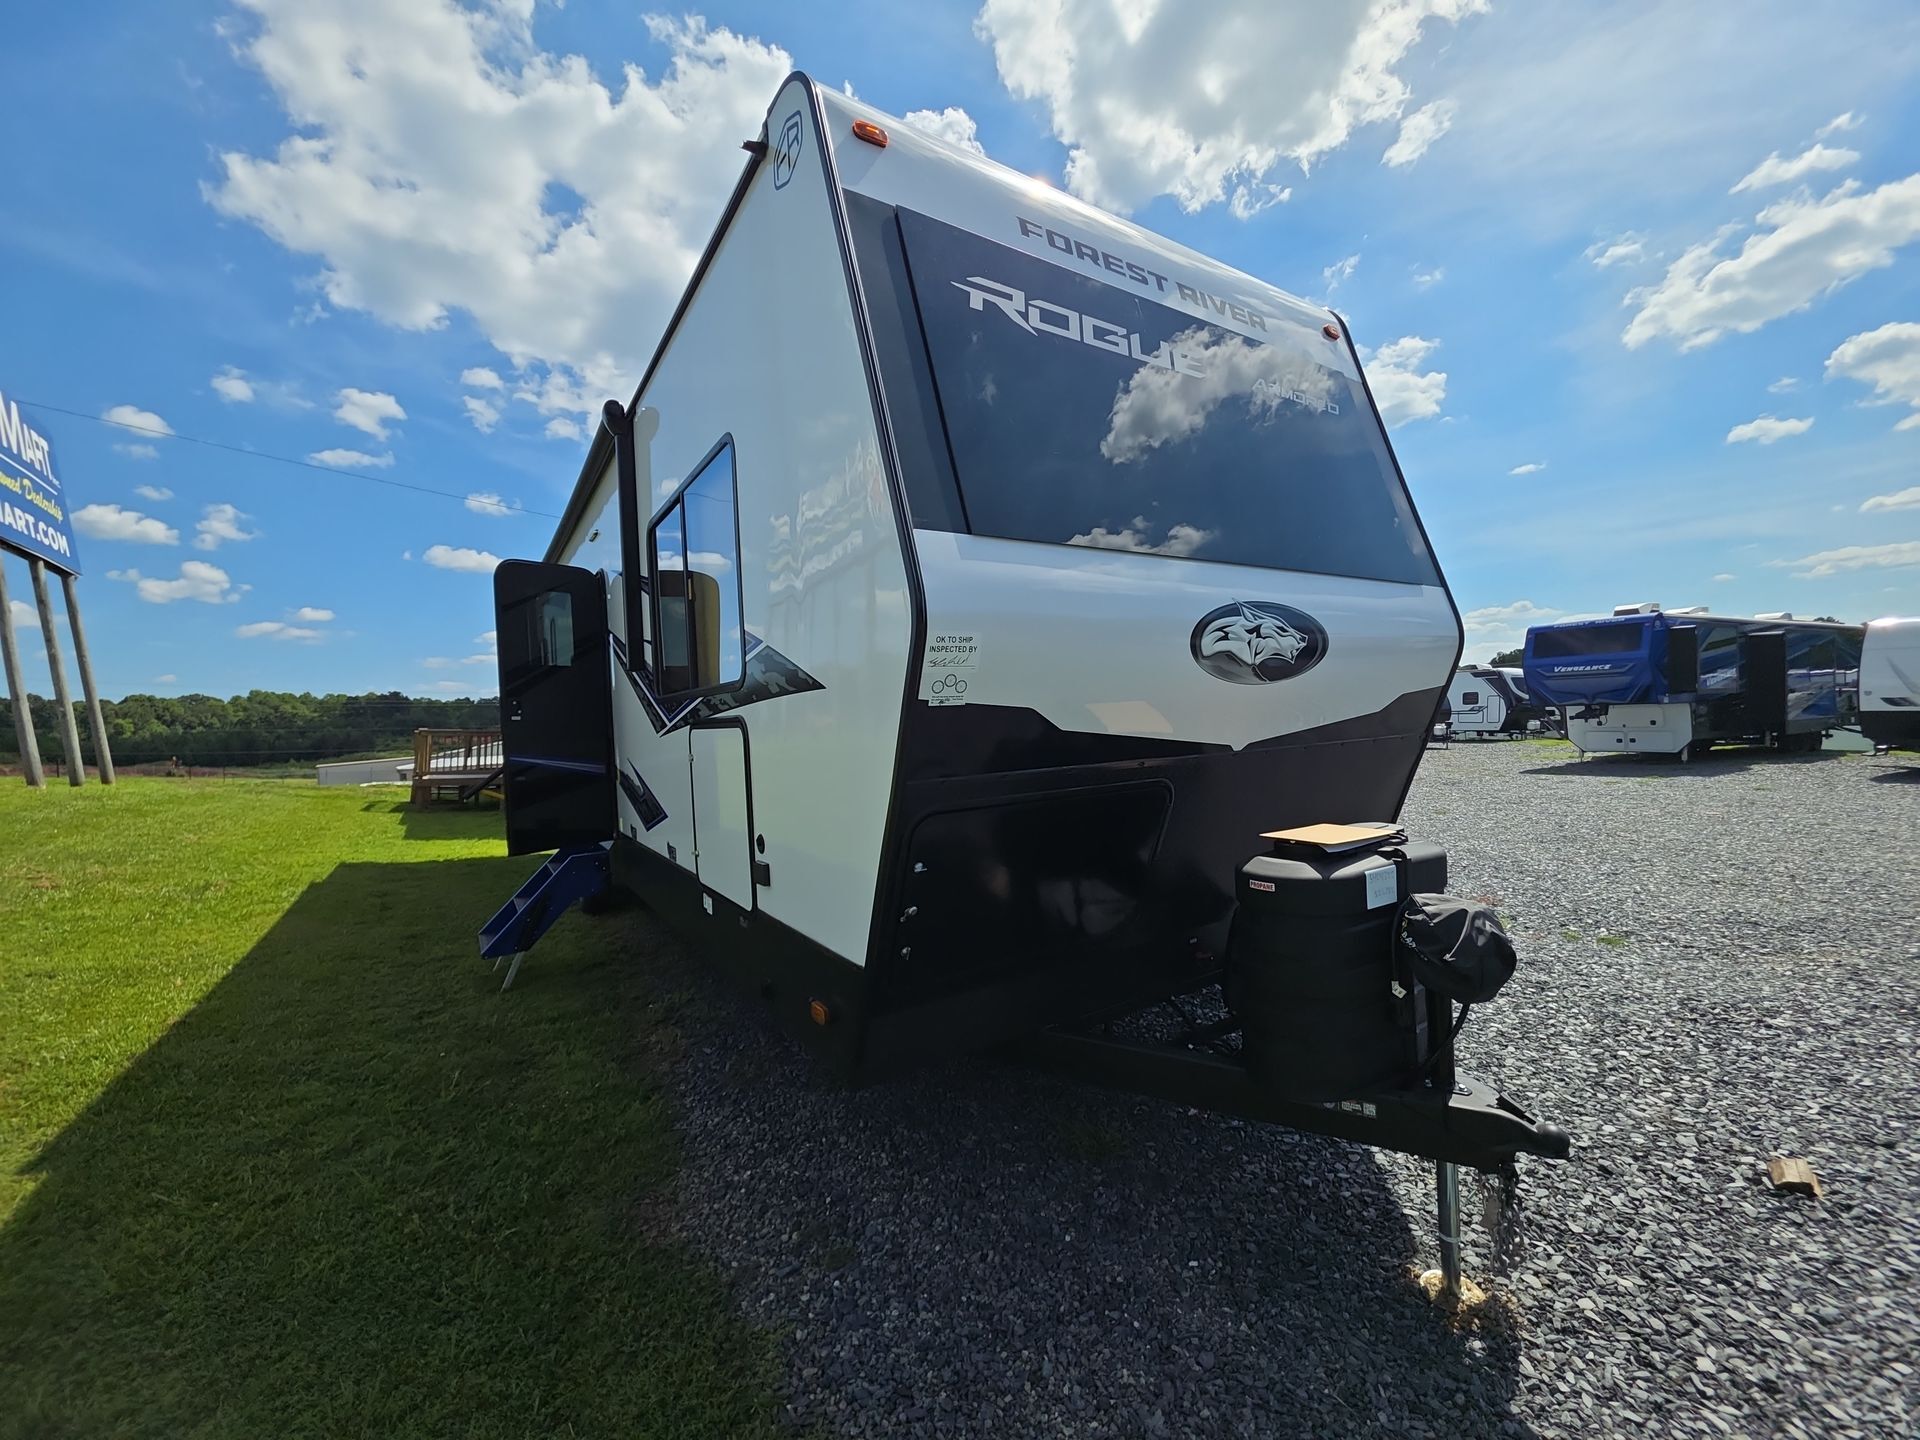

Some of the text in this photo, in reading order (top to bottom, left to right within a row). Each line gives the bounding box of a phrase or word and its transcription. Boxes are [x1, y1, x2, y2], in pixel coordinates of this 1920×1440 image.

[1016, 216, 1268, 332] FOREST RIVER
[950, 276, 1206, 378] ROGUE
[0, 502, 70, 557] ART.COM
[958, 636, 974, 644] SHIP
[968, 645, 978, 653] BY
[1554, 664, 1612, 672] VENGEANCE
[1250, 881, 1274, 891] PROPANE
